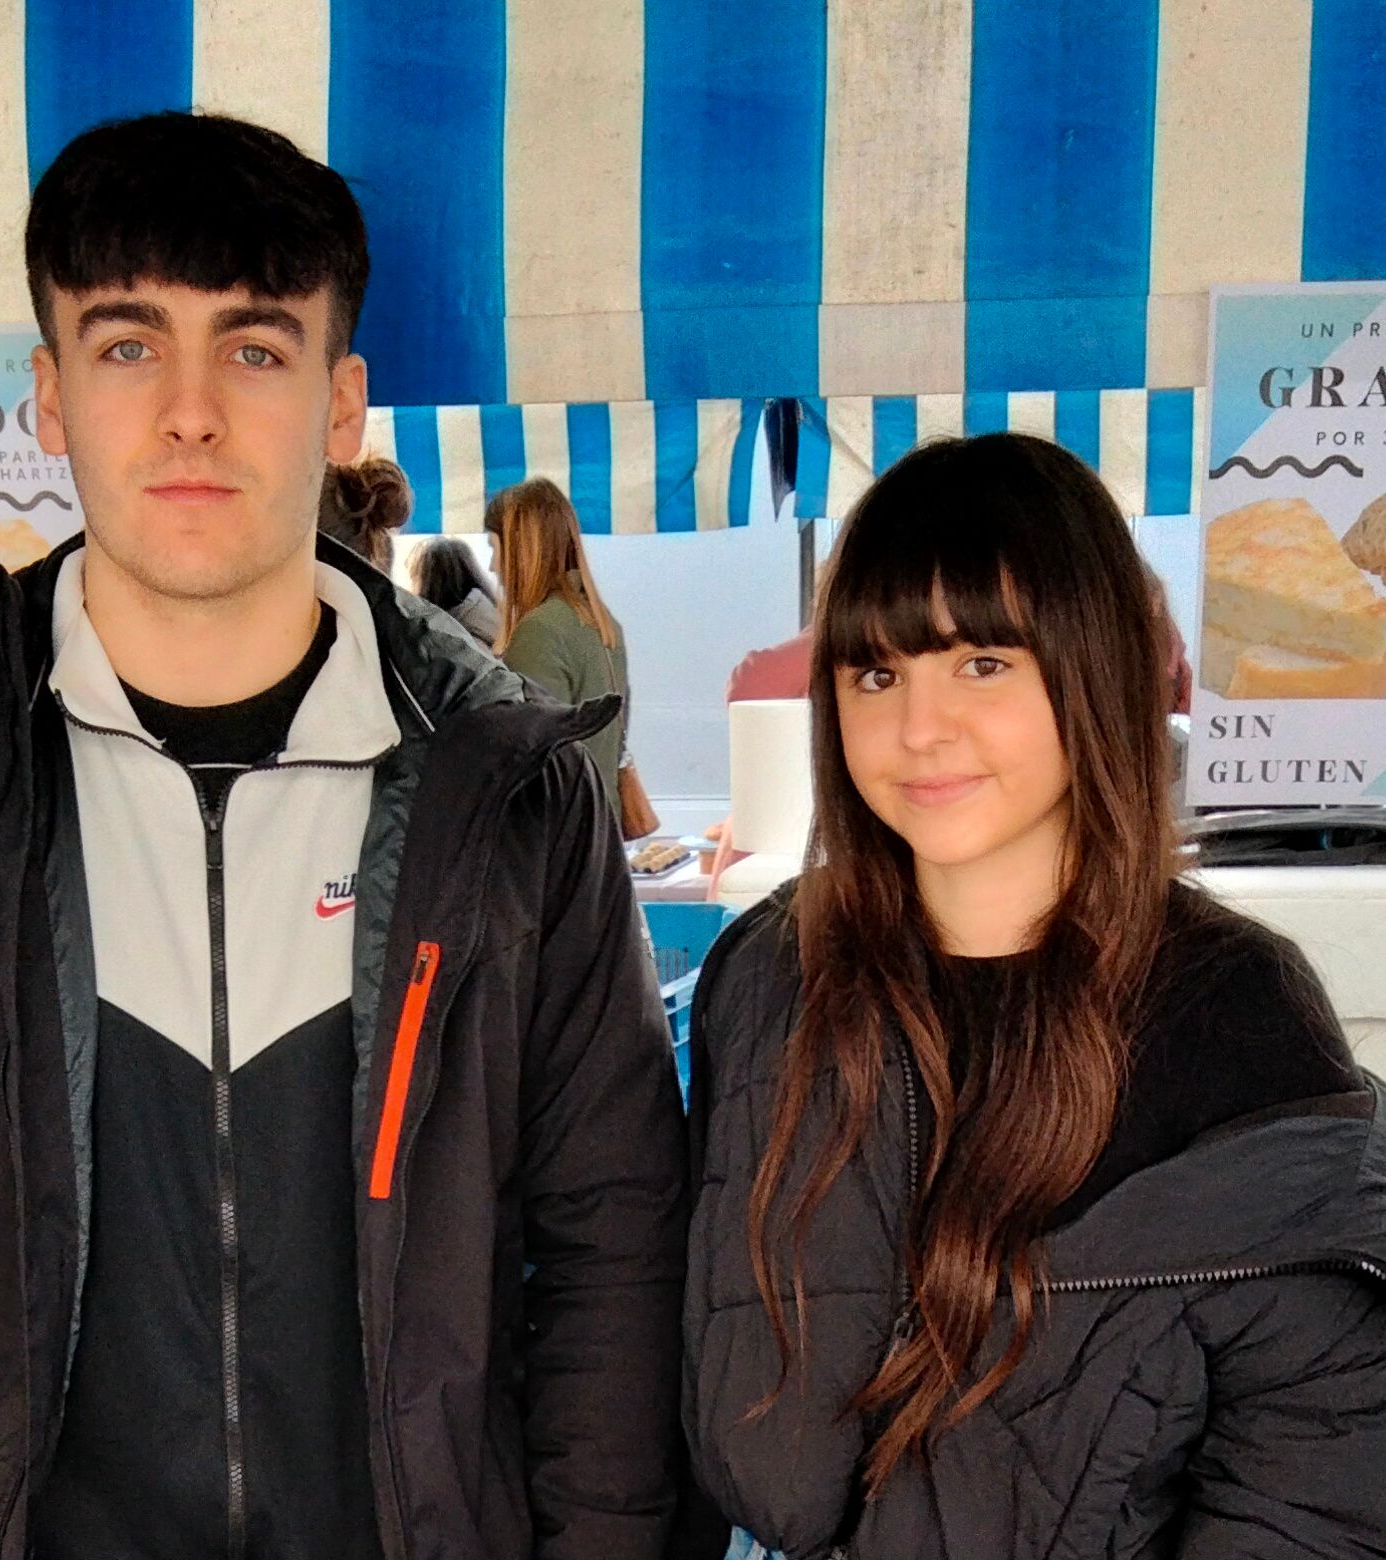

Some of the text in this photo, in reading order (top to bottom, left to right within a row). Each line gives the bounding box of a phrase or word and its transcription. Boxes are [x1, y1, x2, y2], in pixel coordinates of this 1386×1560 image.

[1300, 321, 1335, 339] UN
[1315, 431, 1366, 446] POR
[1207, 713, 1277, 740] SIN
[1207, 759, 1368, 784] GLUTEN
